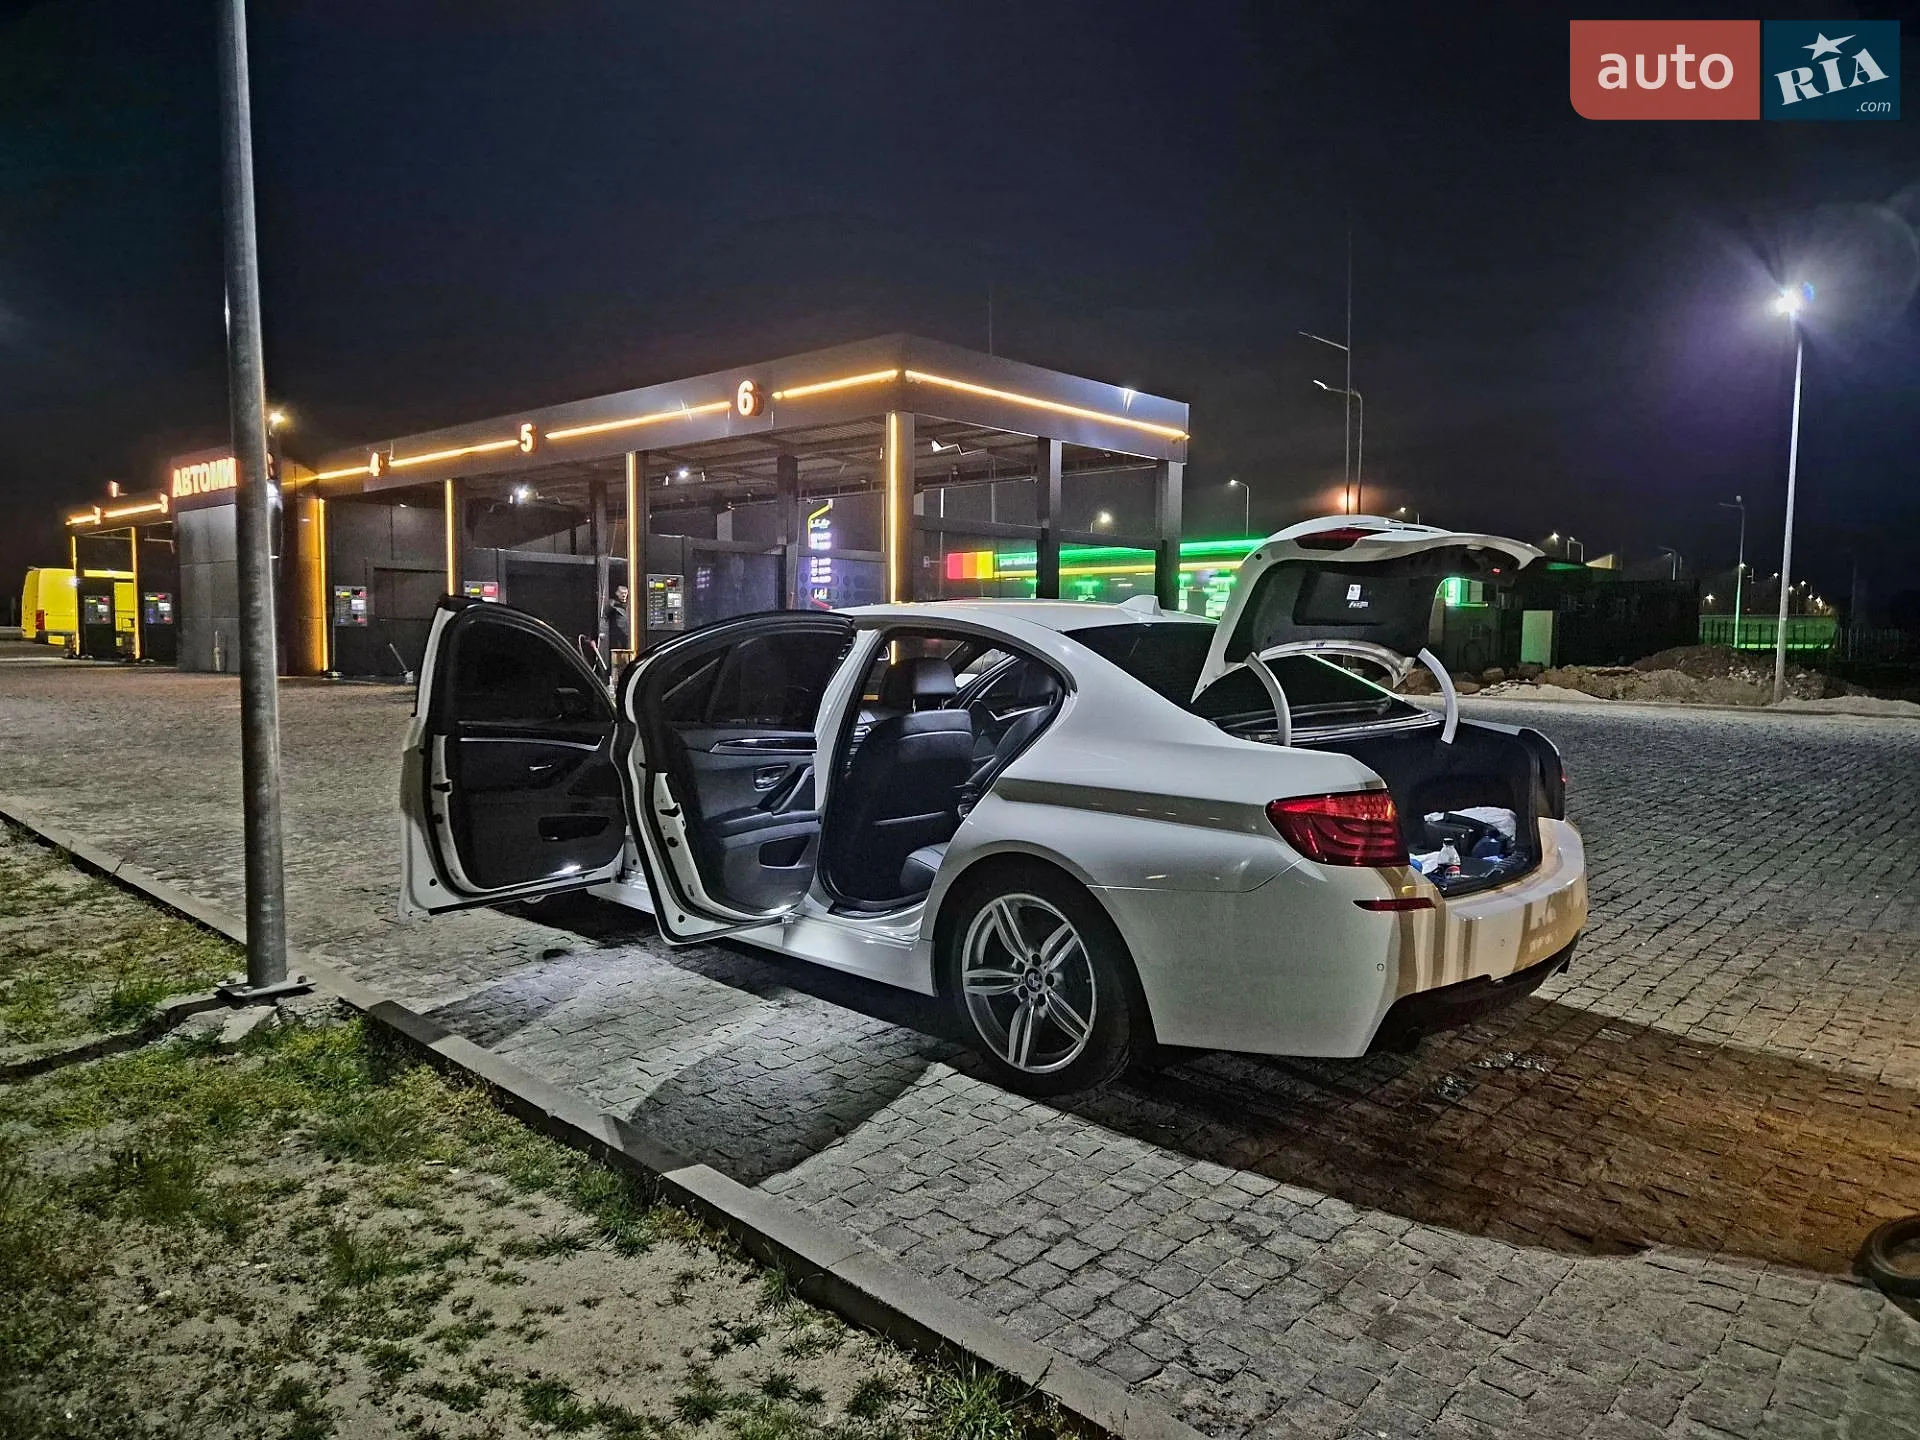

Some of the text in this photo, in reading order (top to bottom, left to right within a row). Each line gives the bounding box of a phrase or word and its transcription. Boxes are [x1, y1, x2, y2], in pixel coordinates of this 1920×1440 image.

[737, 380, 756, 416] 6
[520, 423, 533, 452] 5
[172, 457, 237, 498] АВТОМИ
[369, 452, 381, 477] 4
